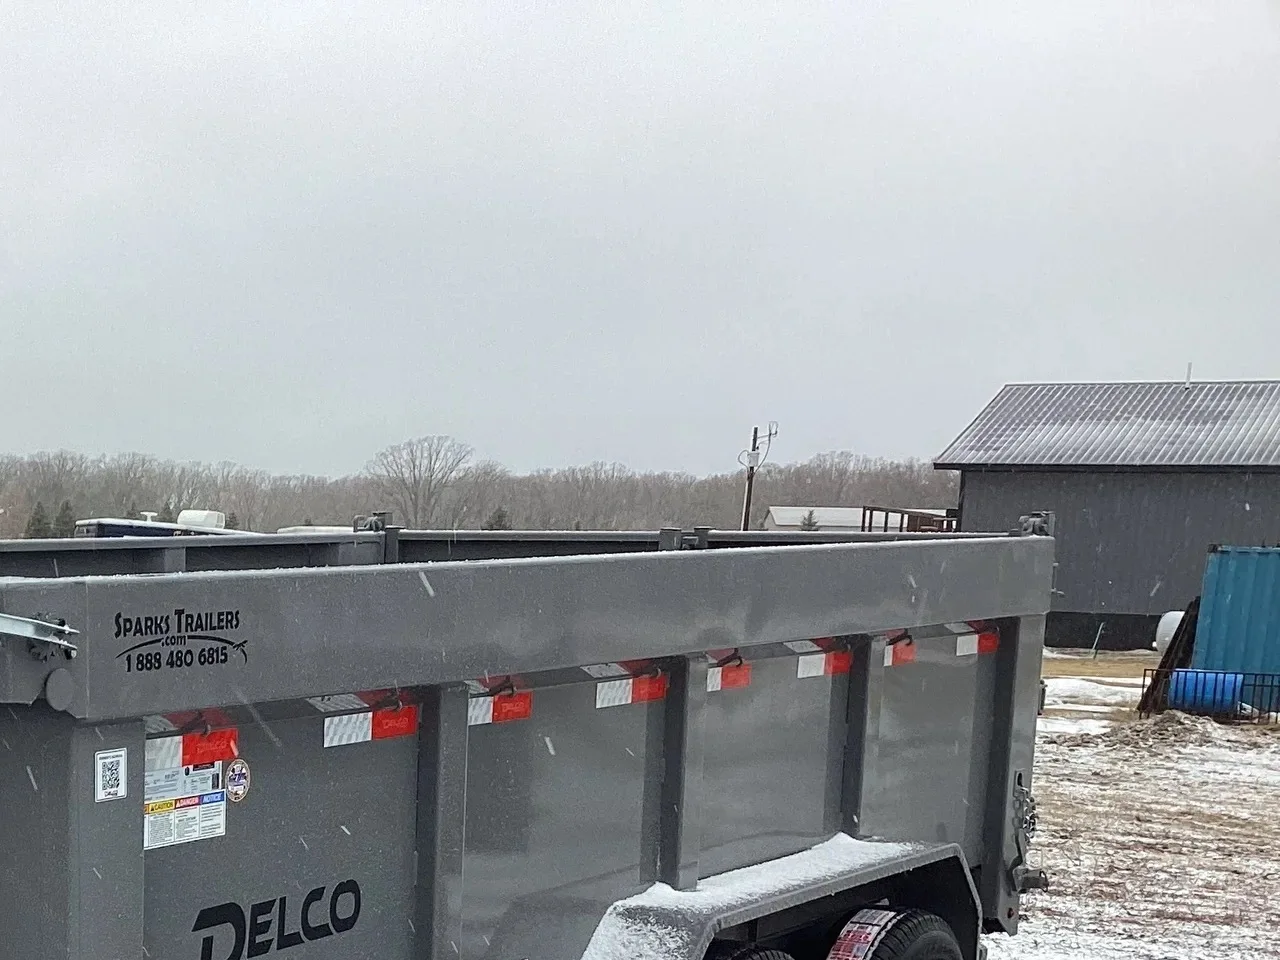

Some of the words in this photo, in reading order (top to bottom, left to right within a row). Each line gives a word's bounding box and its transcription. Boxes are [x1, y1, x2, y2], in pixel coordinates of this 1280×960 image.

[114, 611, 170, 639] SPARKS
[174, 608, 240, 634] TRAILERS
[161, 635, 187, 647] .com
[125, 654, 132, 673] 1
[136, 652, 162, 672] 888
[166, 650, 194, 669] 480
[198, 646, 228, 666] 6815
